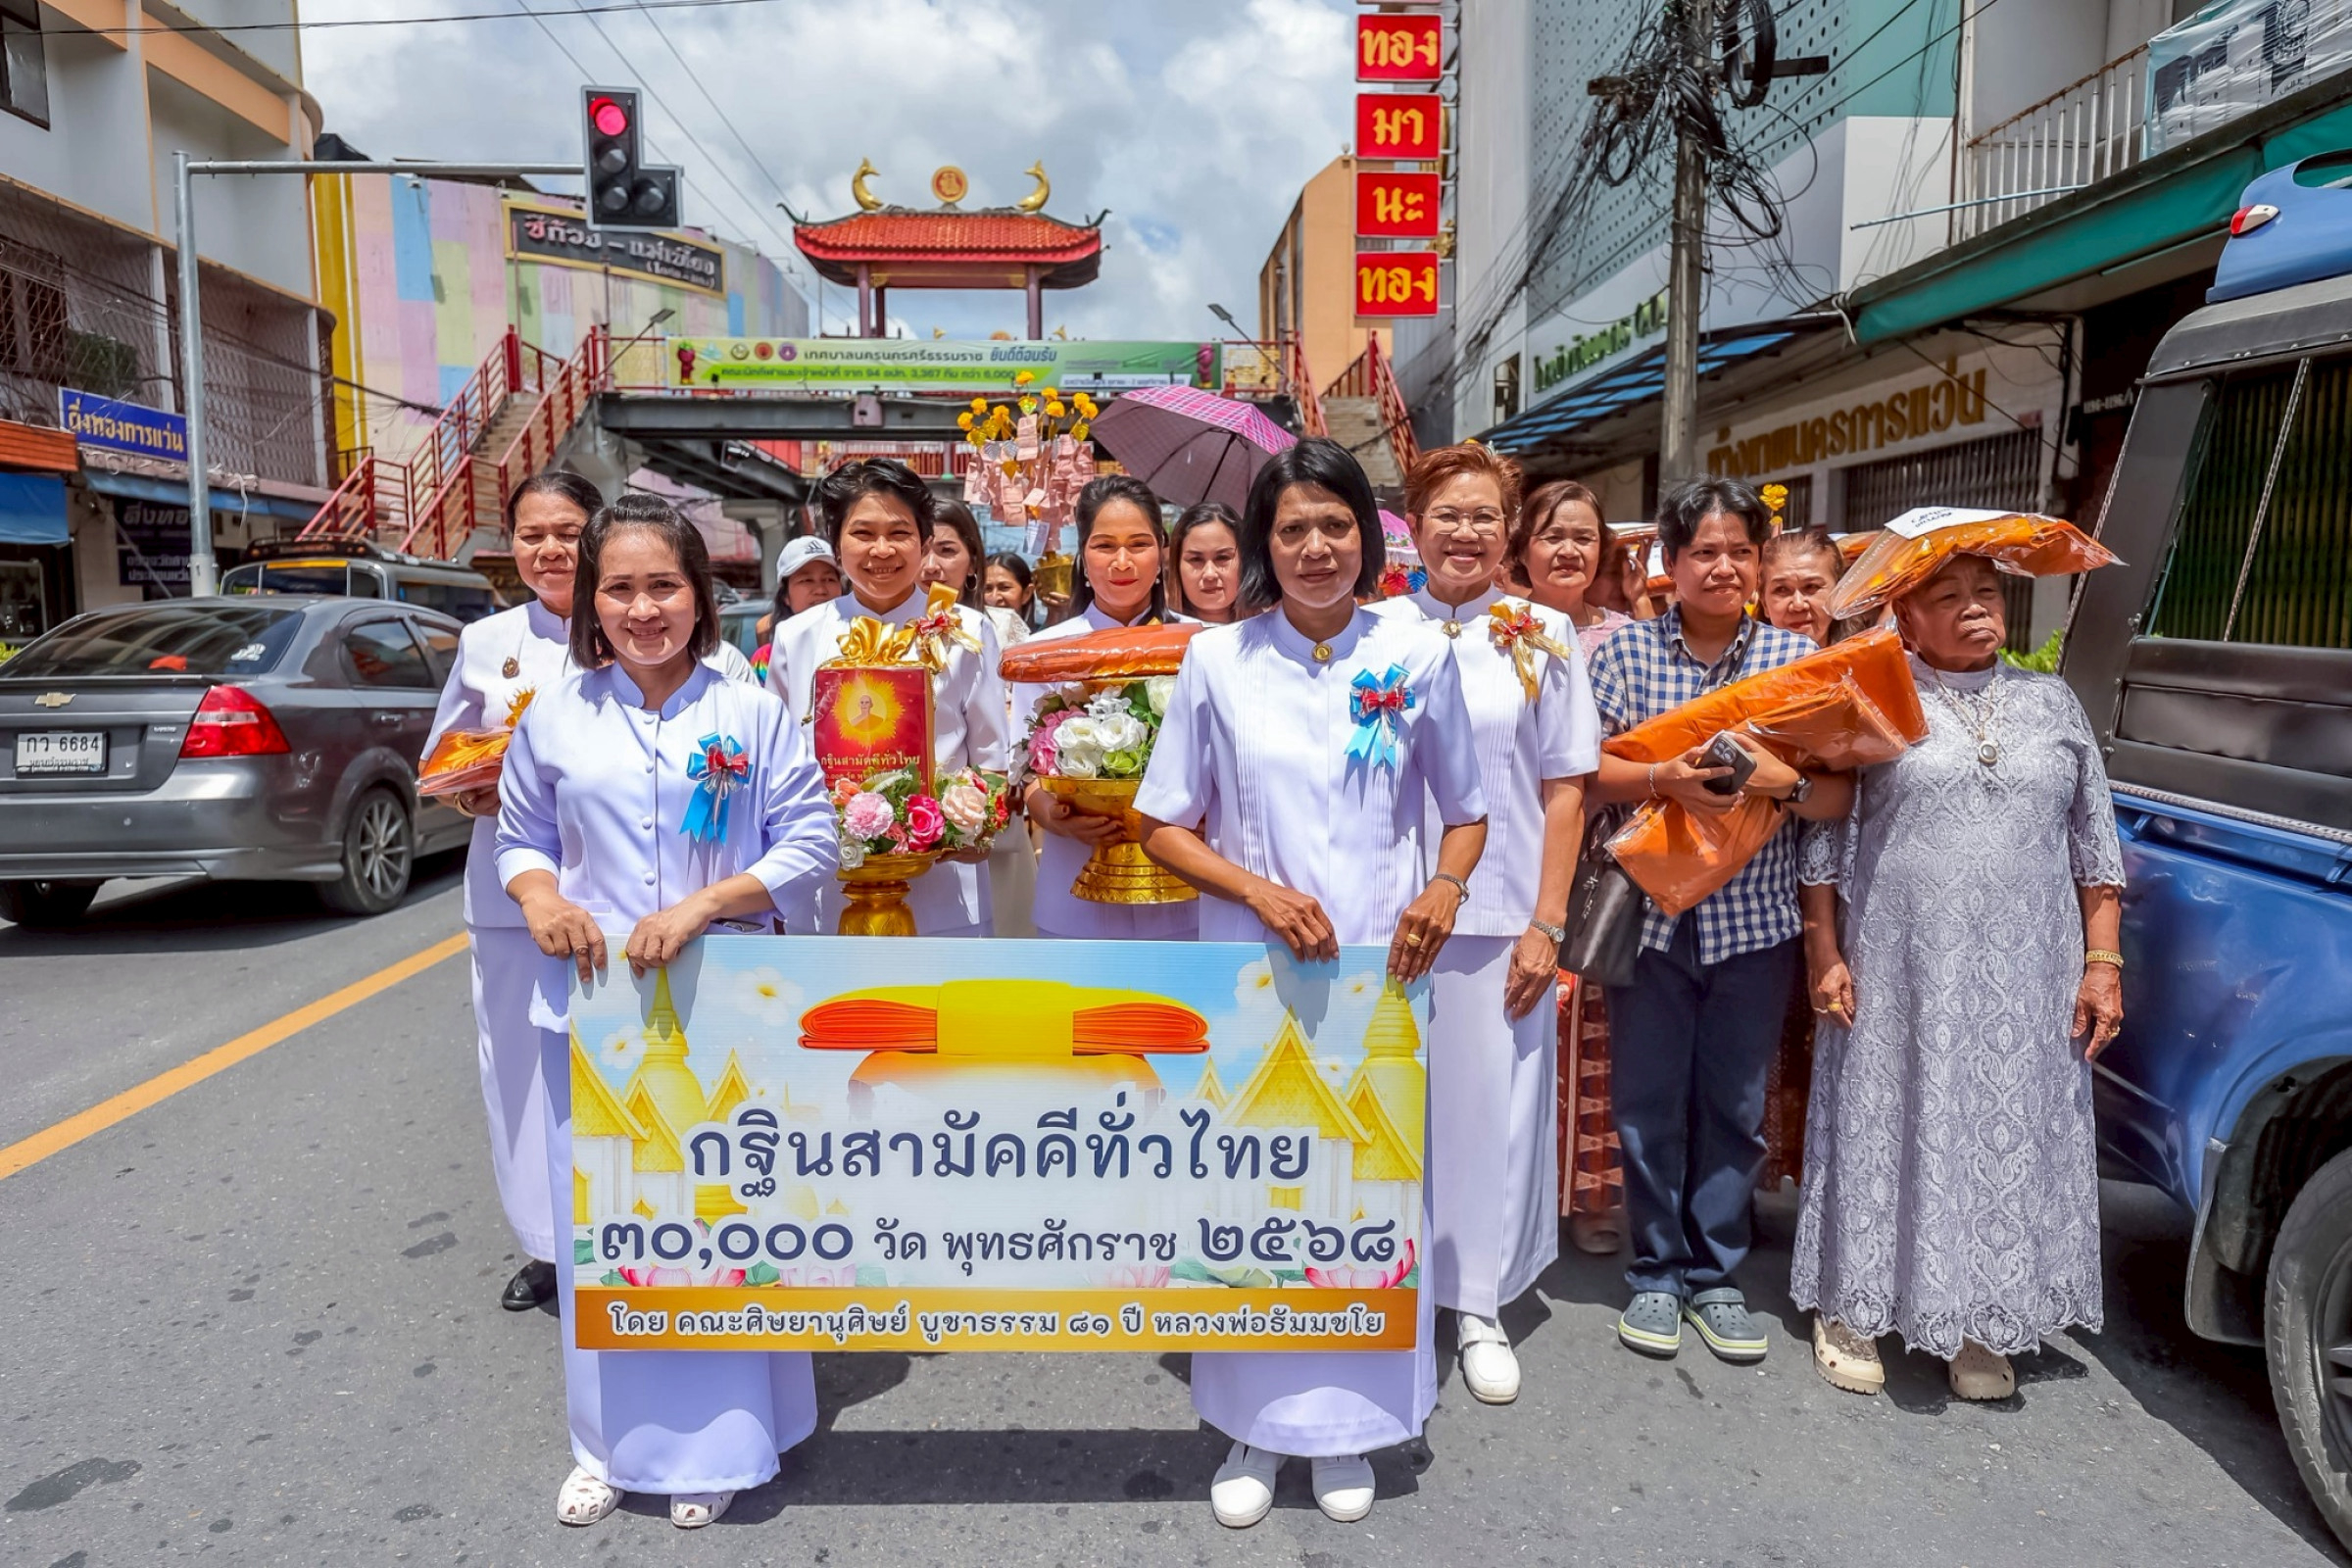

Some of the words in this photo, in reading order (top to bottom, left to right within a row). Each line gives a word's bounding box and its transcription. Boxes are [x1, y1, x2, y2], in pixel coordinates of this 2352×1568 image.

[1359, 28, 1439, 68] ทอง
[1371, 107, 1424, 146] มา
[1373, 185, 1425, 223] นะ
[1358, 266, 1435, 304] ทอง
[804, 348, 983, 363] เทศบาลนครนครศรีธรรมราช
[990, 347, 1057, 363] ยินดีต้อนรับ
[59, 736, 100, 753] 6684
[688, 1090, 1311, 1199] กฐินสามัคคีทั่วไทย
[601, 1219, 854, 1270] ๓๐,๐๐๐
[873, 1217, 927, 1261] วัด
[943, 1218, 1178, 1278] พุทธศักราช
[1198, 1215, 1397, 1263] ๒๕๖๘
[610, 1304, 665, 1333] โดย
[678, 1303, 907, 1342] คณะศิษยานุศิษย์
[919, 1311, 1056, 1343] บูชาธรรม
[1069, 1312, 1110, 1335] ๘๑
[1122, 1303, 1142, 1333] ปี
[1153, 1304, 1384, 1334] หลวงพ่อธัมมชโย
